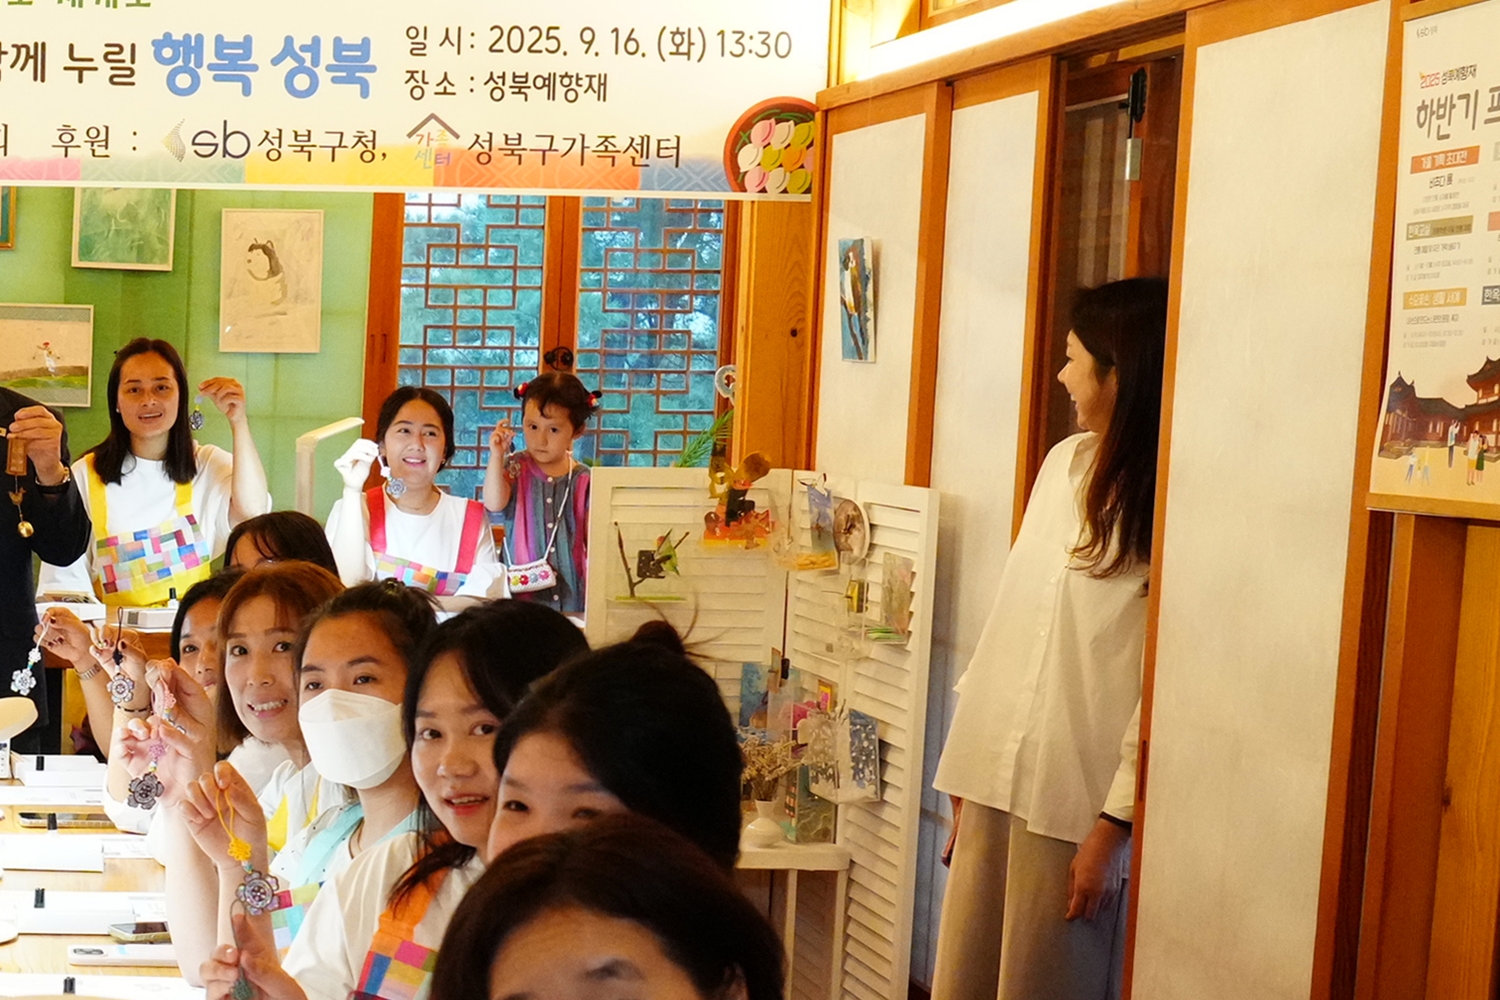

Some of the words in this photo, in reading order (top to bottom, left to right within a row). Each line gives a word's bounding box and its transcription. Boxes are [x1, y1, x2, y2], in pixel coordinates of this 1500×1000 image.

[62, 42, 137, 87] 누릴
[150, 31, 260, 98] 행복
[270, 34, 378, 100] 성북
[487, 24, 568, 57] 2025.
[579, 25, 600, 58] 9.
[610, 26, 647, 59] 16.
[657, 25, 707, 64] (화)
[716, 29, 792, 59] 13:30
[483, 70, 608, 104] 성북예향재
[1420, 71, 1441, 89] 2025
[1416, 88, 1480, 141] 하반기
[51, 123, 111, 159] 후원
[190, 119, 252, 159] sb
[257, 127, 388, 164] 성북구청,
[467, 130, 682, 169] 성북구가족센터
